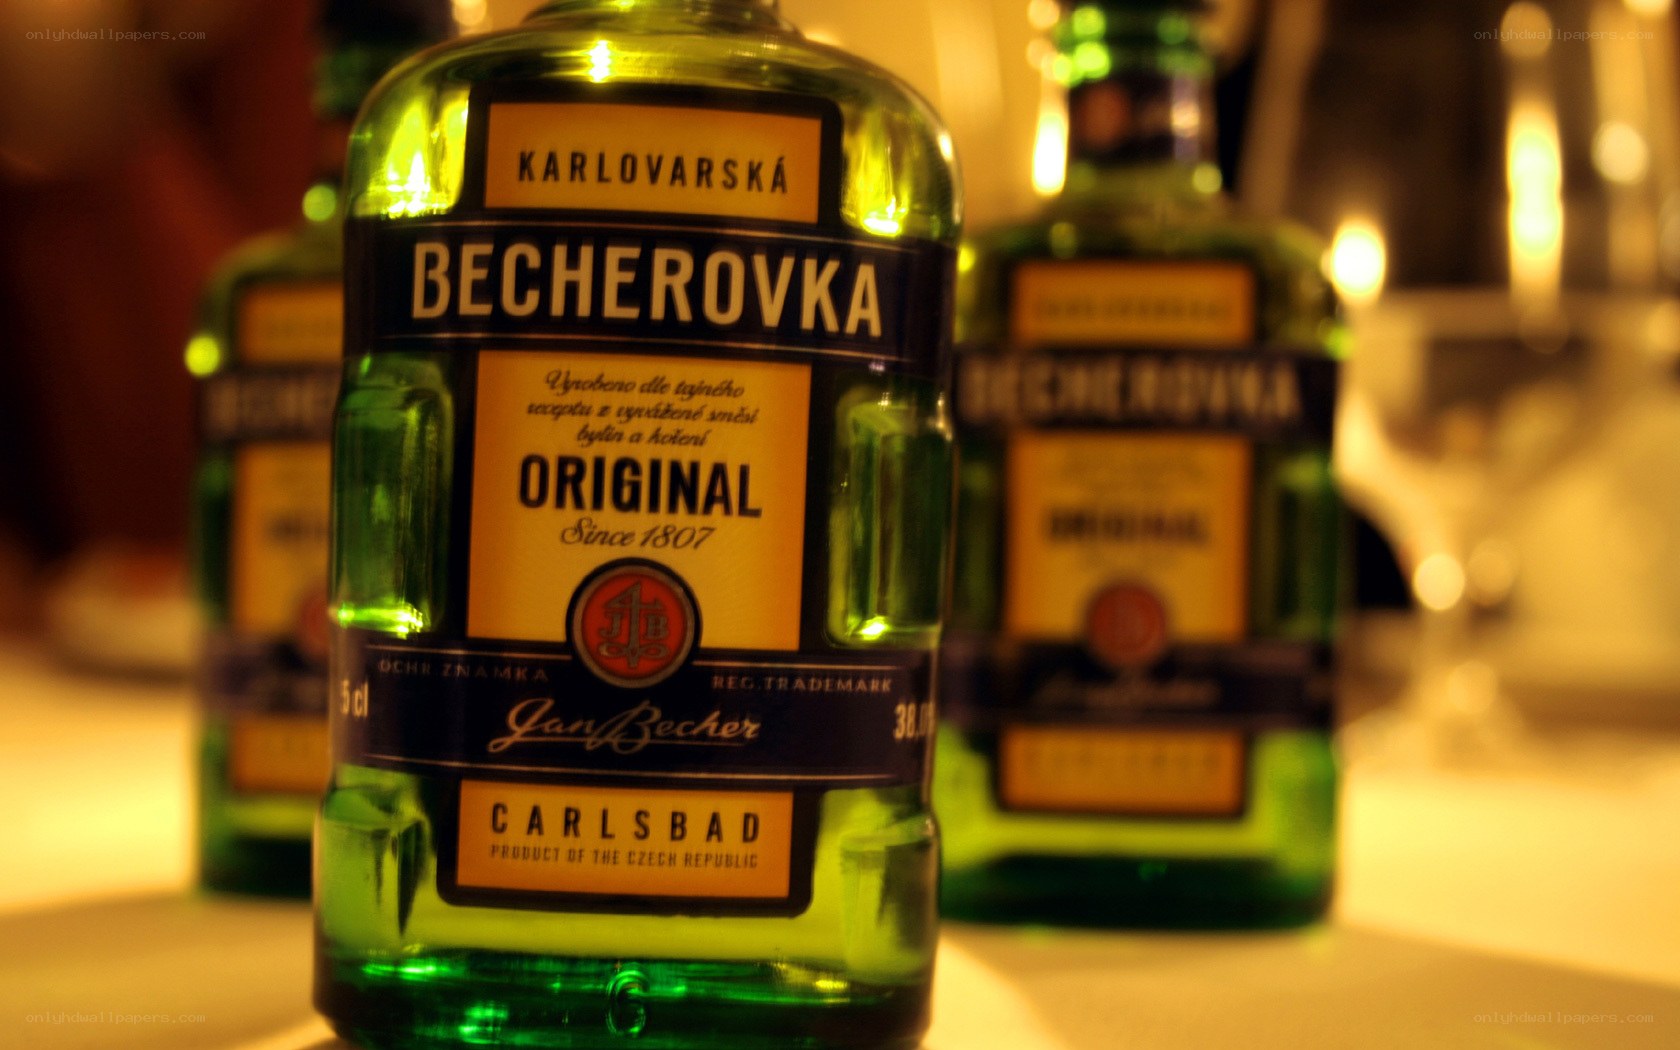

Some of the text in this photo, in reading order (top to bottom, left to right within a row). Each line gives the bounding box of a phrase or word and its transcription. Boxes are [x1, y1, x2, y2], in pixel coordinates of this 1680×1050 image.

[517, 149, 789, 196] KARLOVARSKÁ
[411, 240, 883, 339] BECHEROVKA
[545, 369, 744, 401] Vyrobeno dle tajného
[527, 400, 593, 420] receptu
[597, 404, 611, 418] z
[616, 404, 706, 424] vyvážené
[576, 423, 712, 447] bylin a koření
[518, 454, 763, 519] ORIGINAL
[560, 517, 716, 550] Since 1807
[340, 679, 369, 718] 5 cl
[487, 697, 761, 754] Jan Becher
[491, 802, 761, 844] CARLSBAD
[490, 843, 758, 869] PRODUCT OF THE CZECH REPUBLIC
